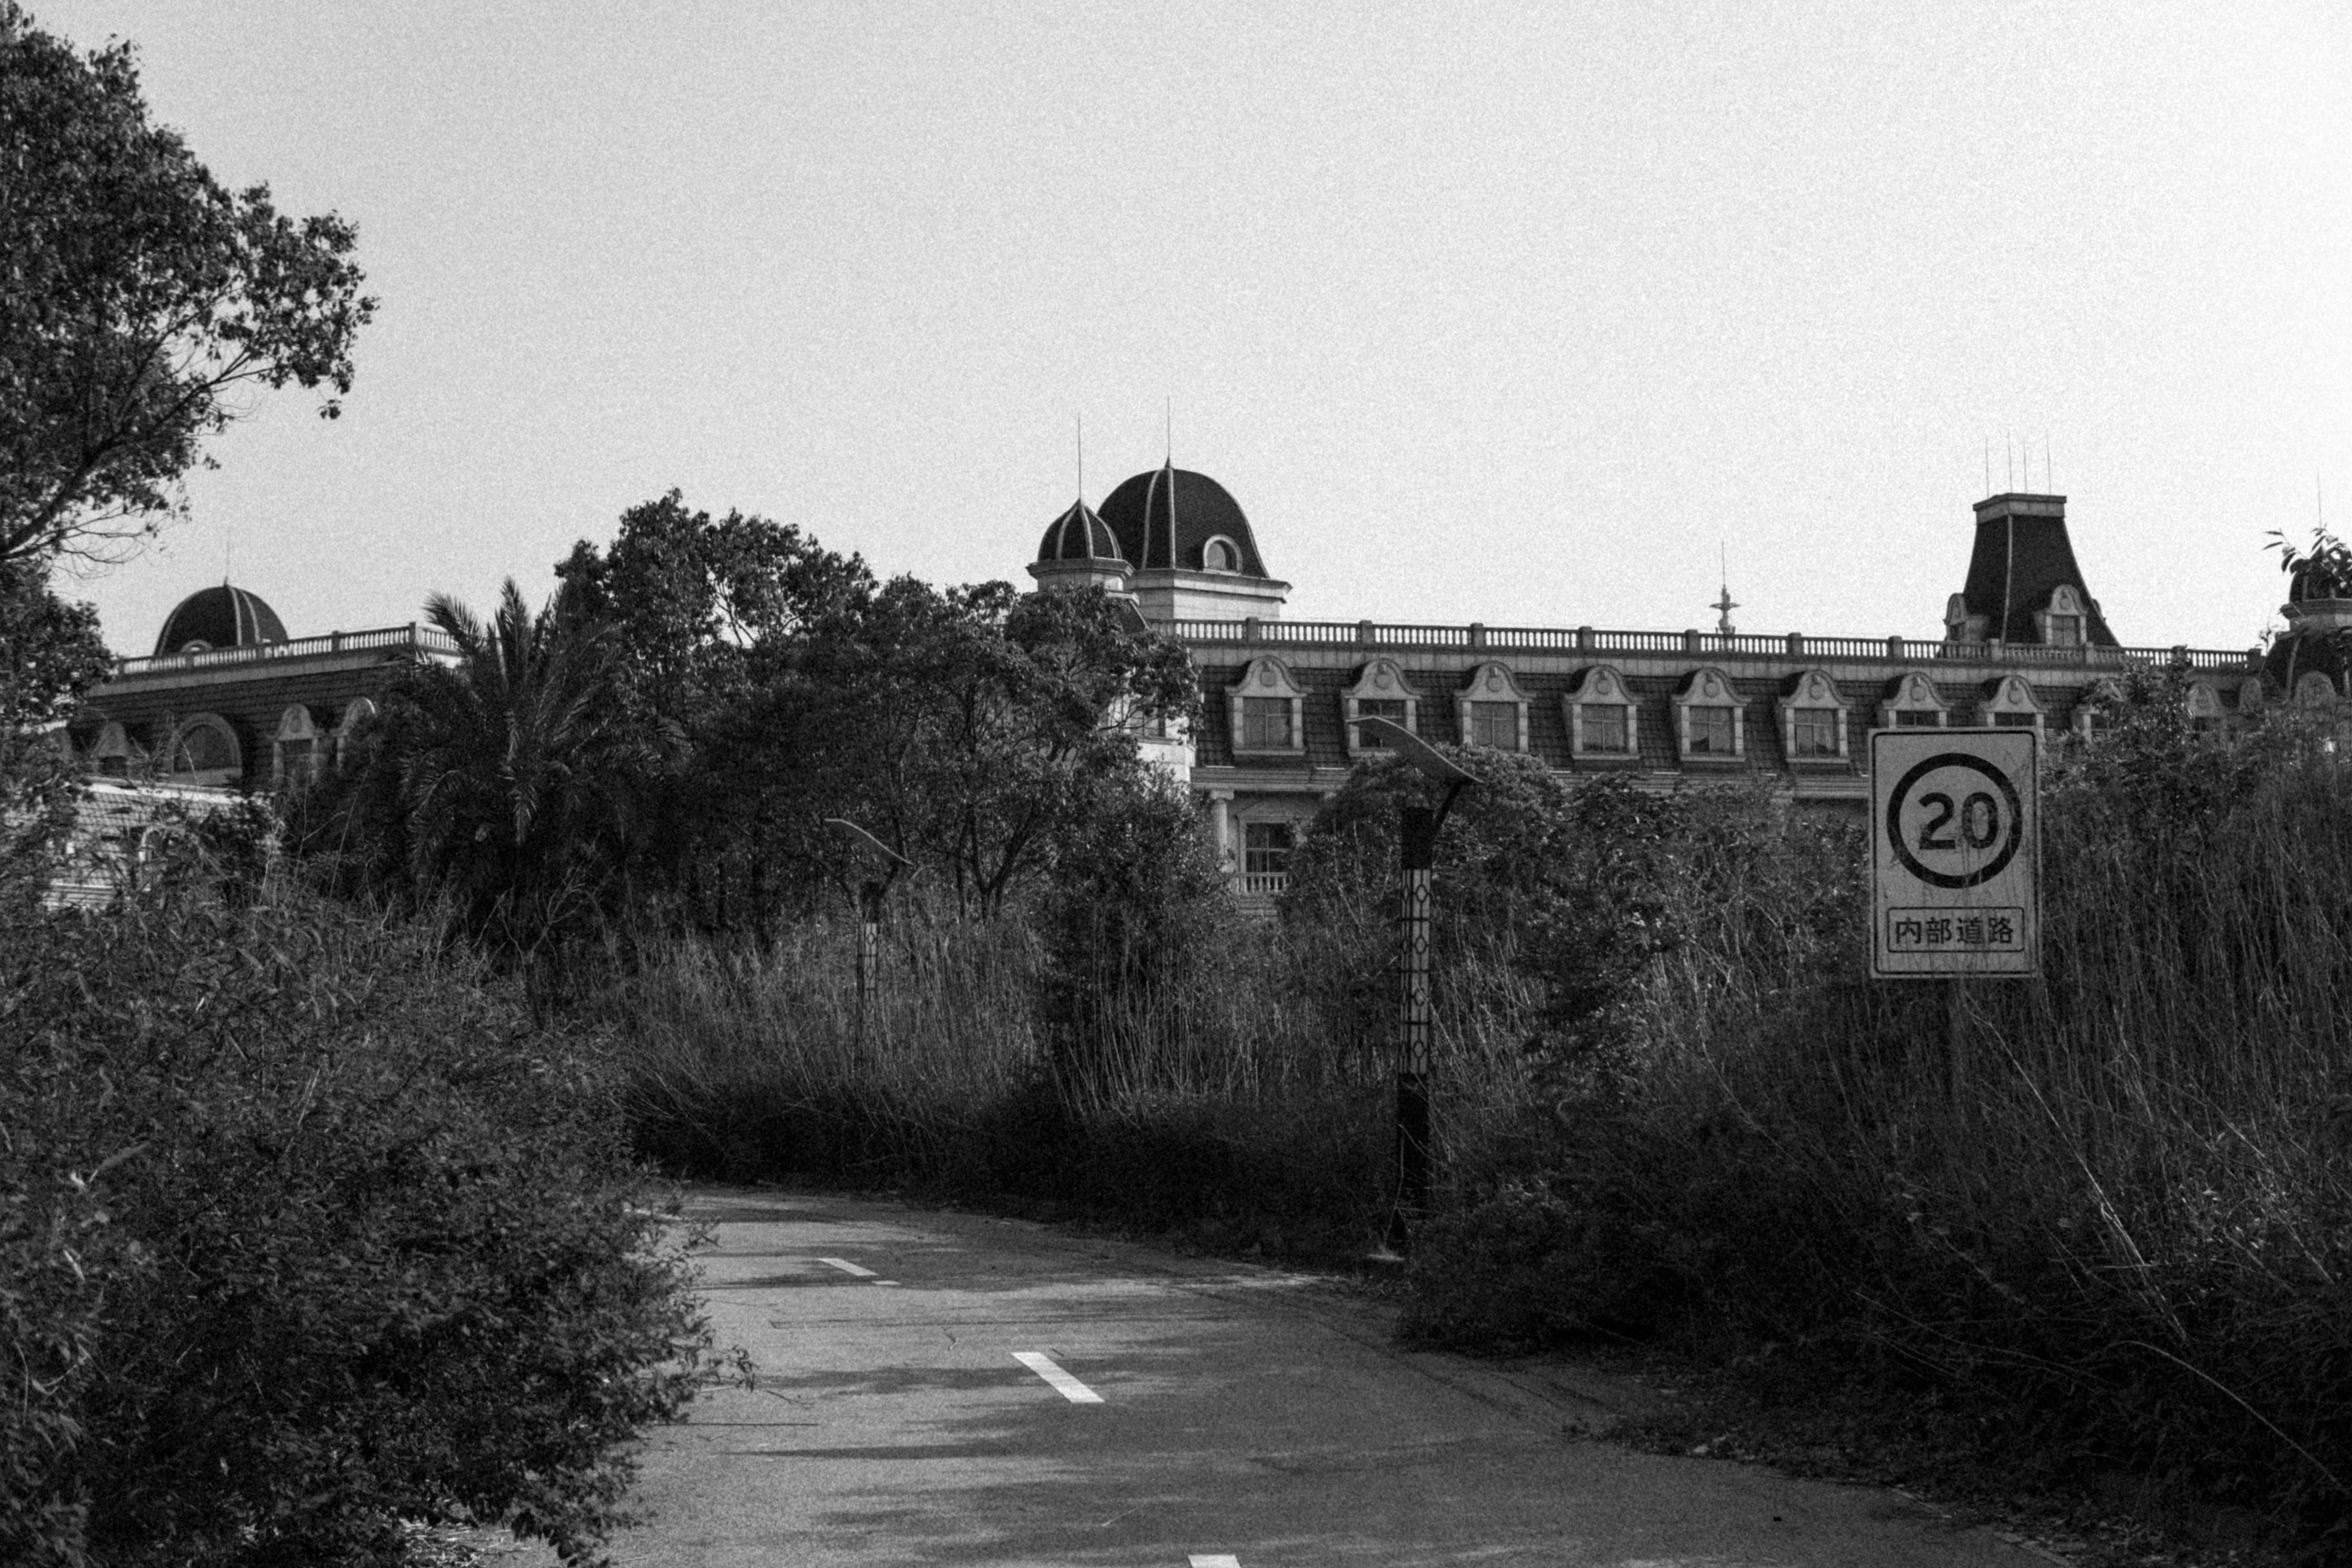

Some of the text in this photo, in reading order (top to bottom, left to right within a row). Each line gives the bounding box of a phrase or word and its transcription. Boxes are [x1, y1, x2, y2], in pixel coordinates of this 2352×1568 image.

[1918, 791, 1998, 850] 20
[1895, 917, 2014, 944] 内部道路
